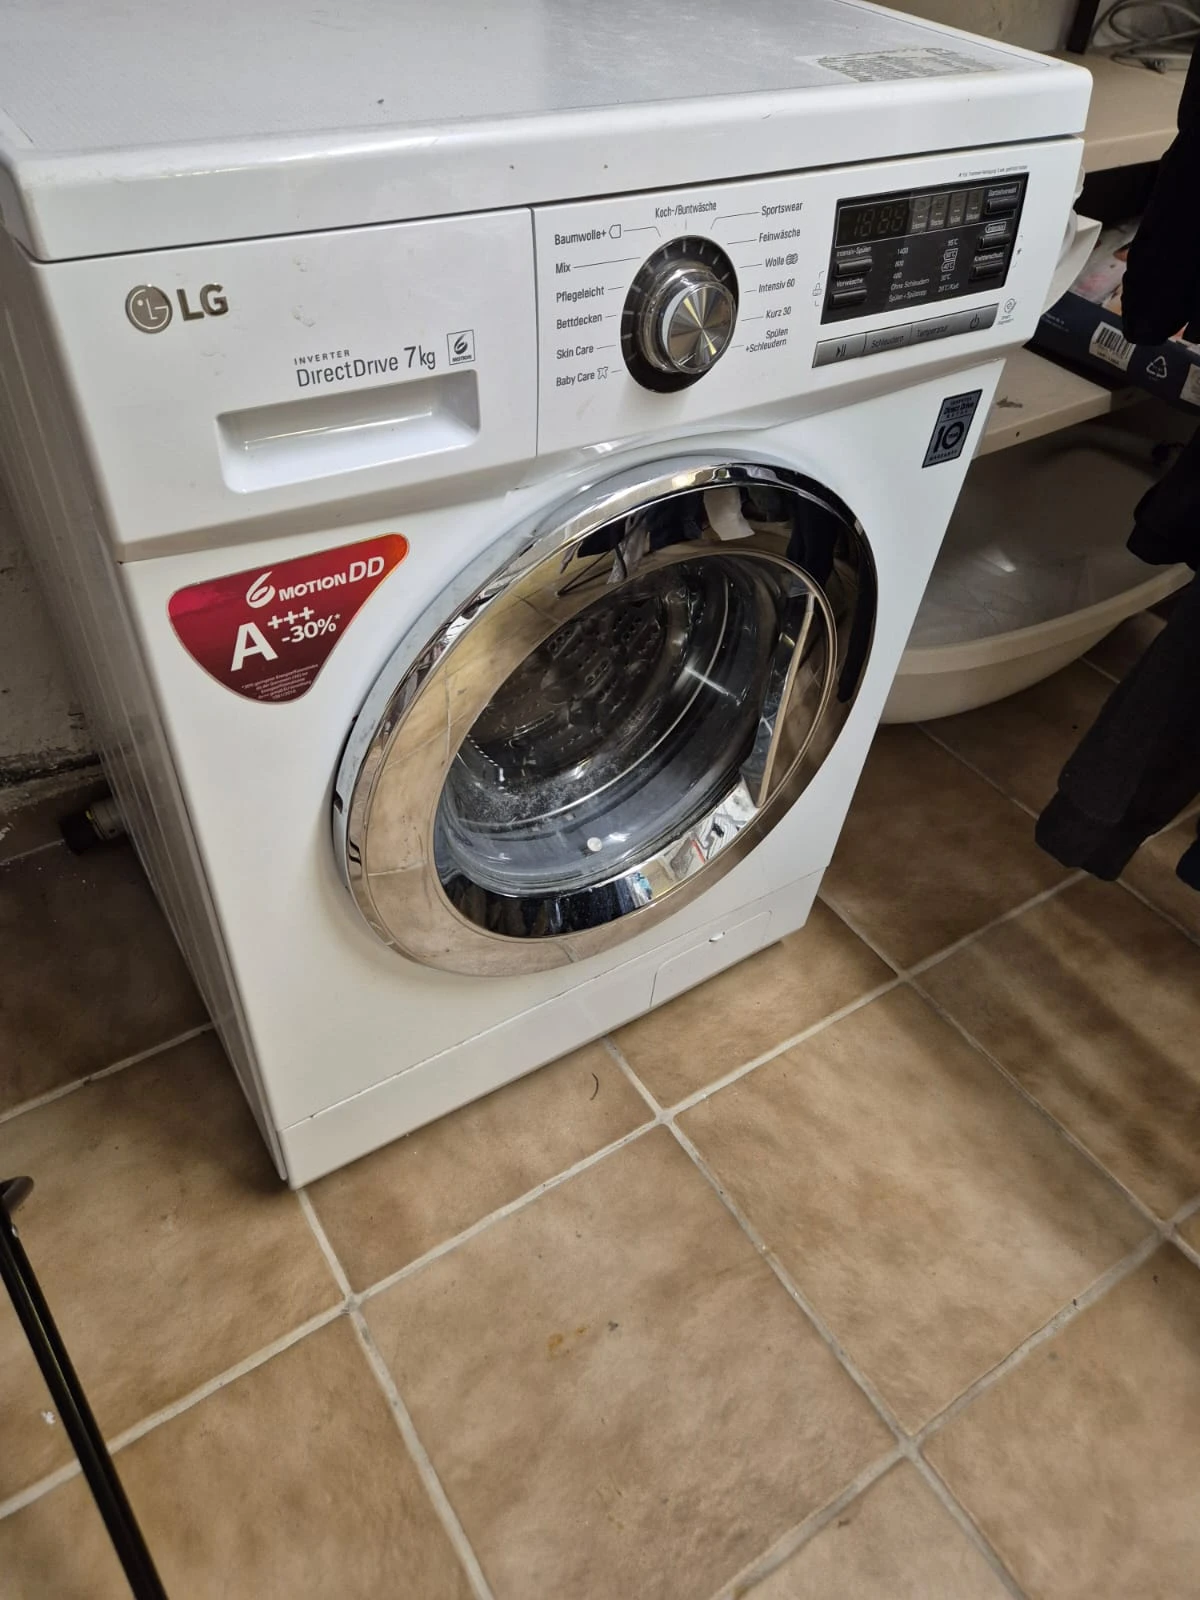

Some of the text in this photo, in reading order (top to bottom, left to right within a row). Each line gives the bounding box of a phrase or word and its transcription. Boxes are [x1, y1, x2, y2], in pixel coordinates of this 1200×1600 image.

[655, 200, 717, 219] Koch-/Buntwäsche
[760, 200, 804, 217] Sportswear
[554, 227, 606, 246] Baumwolle+
[758, 228, 801, 243] Feinwäsche
[555, 262, 571, 274] Mix
[764, 255, 785, 267] Wolle
[758, 278, 796, 293] Intensiv 60
[176, 283, 229, 322] LG
[556, 285, 605, 304] Pflegeleicht
[765, 305, 792, 319] Kurz 30
[556, 312, 603, 330] Bettdecken
[765, 327, 789, 340] Spülen
[293, 349, 350, 366] INVERTER
[556, 344, 594, 360] Skin Care
[555, 370, 595, 387] Baby Care
[278, 572, 347, 602] MOTION
[348, 555, 385, 583] DD
